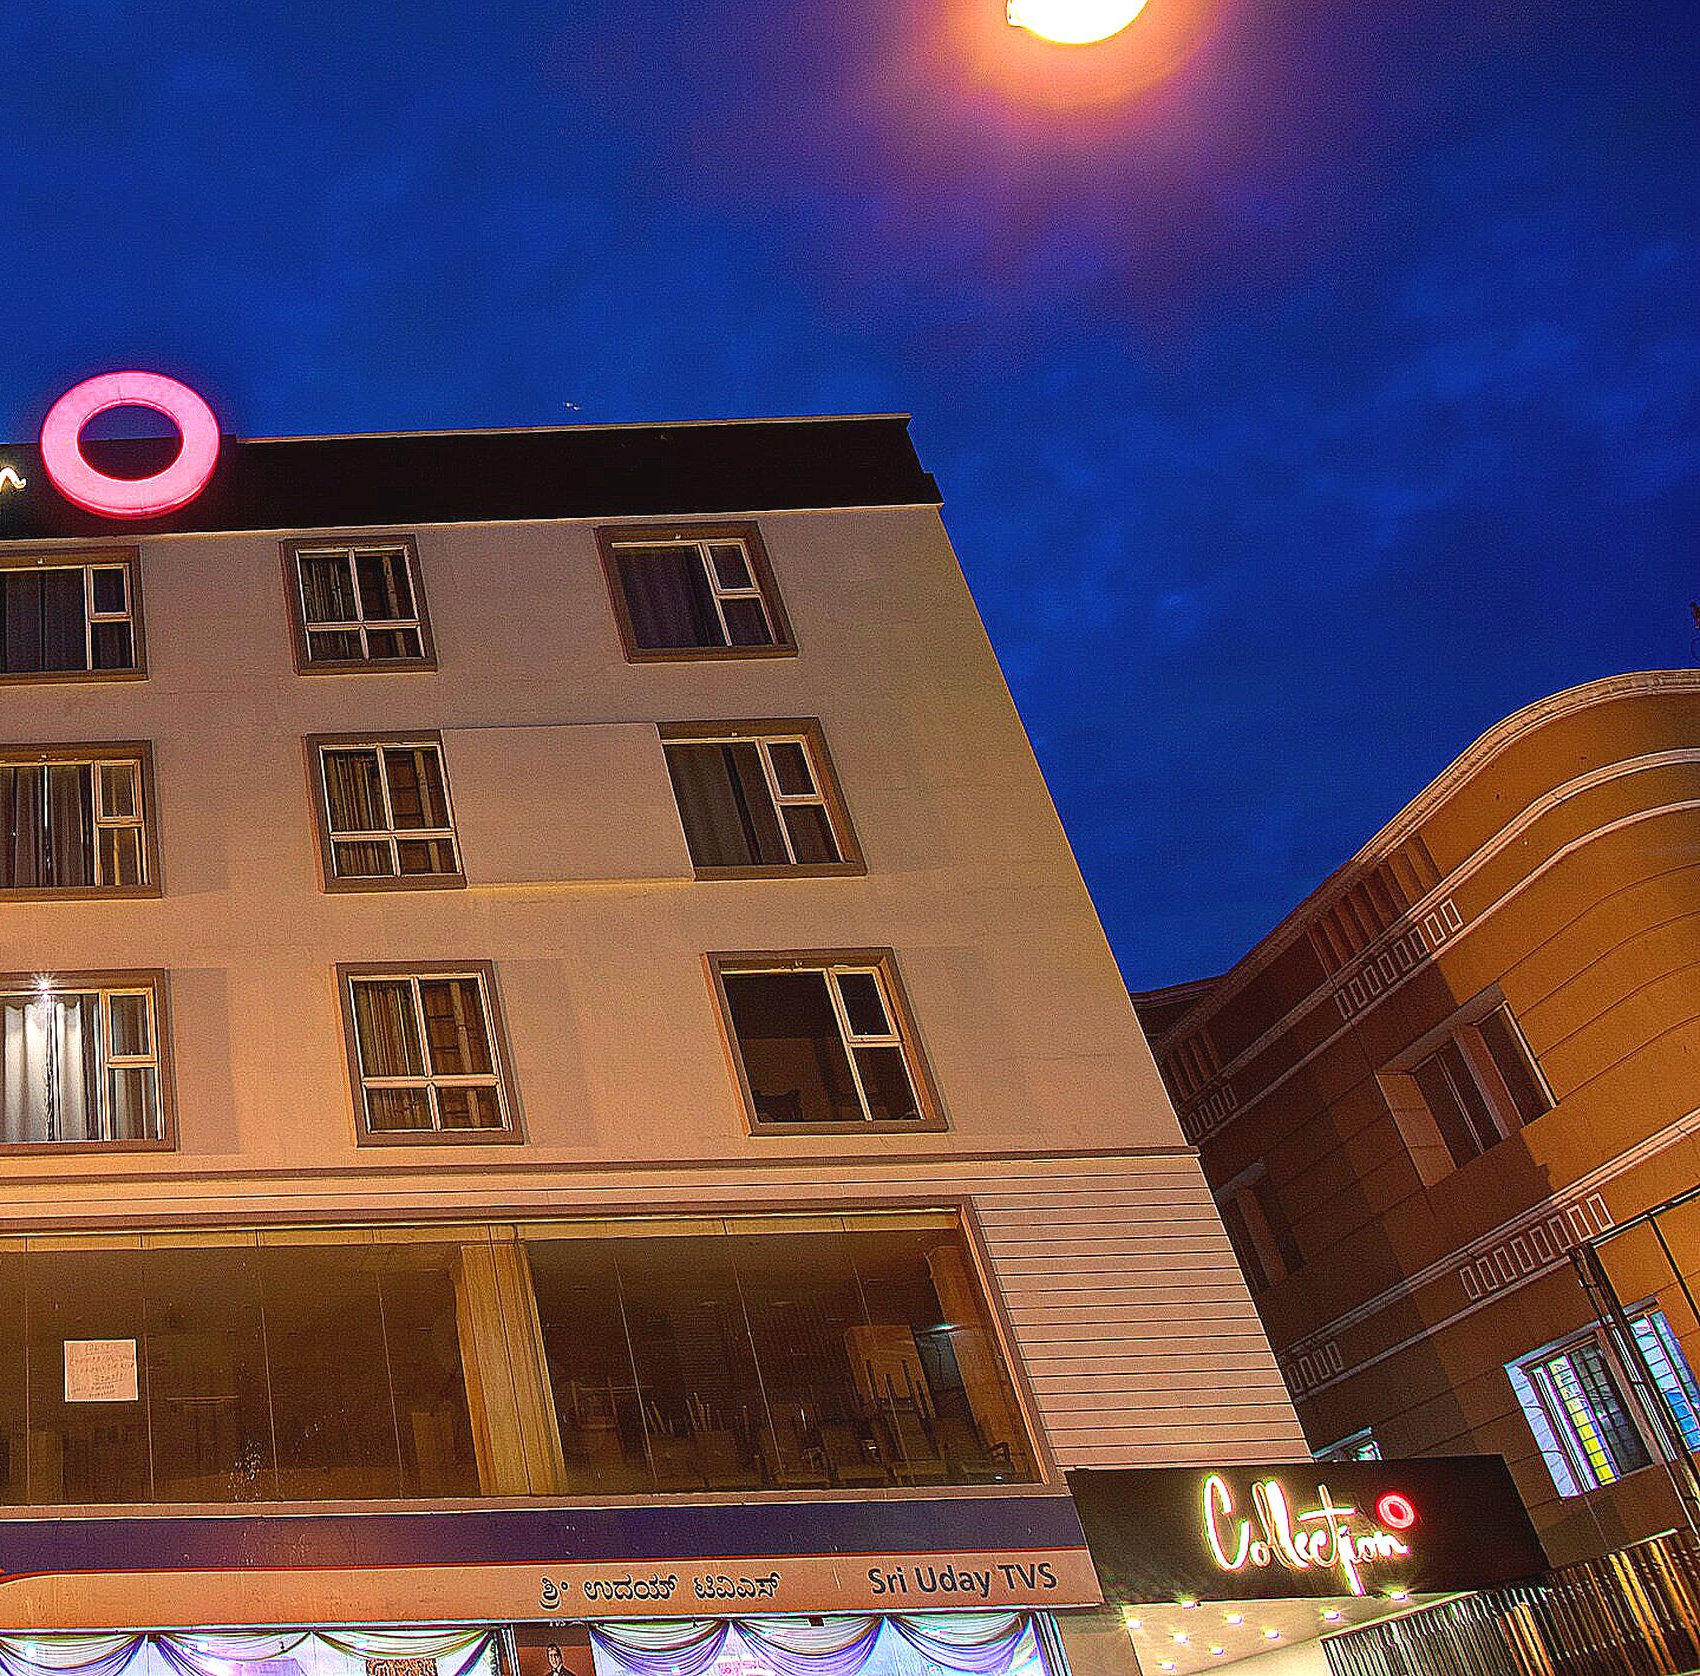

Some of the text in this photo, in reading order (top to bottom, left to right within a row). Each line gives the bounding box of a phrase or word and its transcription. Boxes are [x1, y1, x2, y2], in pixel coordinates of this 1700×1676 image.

[1200, 1472, 1409, 1598] Collection
[583, 1573, 678, 1601] ಉದಯ್
[692, 1571, 780, 1599] ಟಿವಿಎಸ್
[867, 1561, 1058, 1599] Sri Uday TVS
